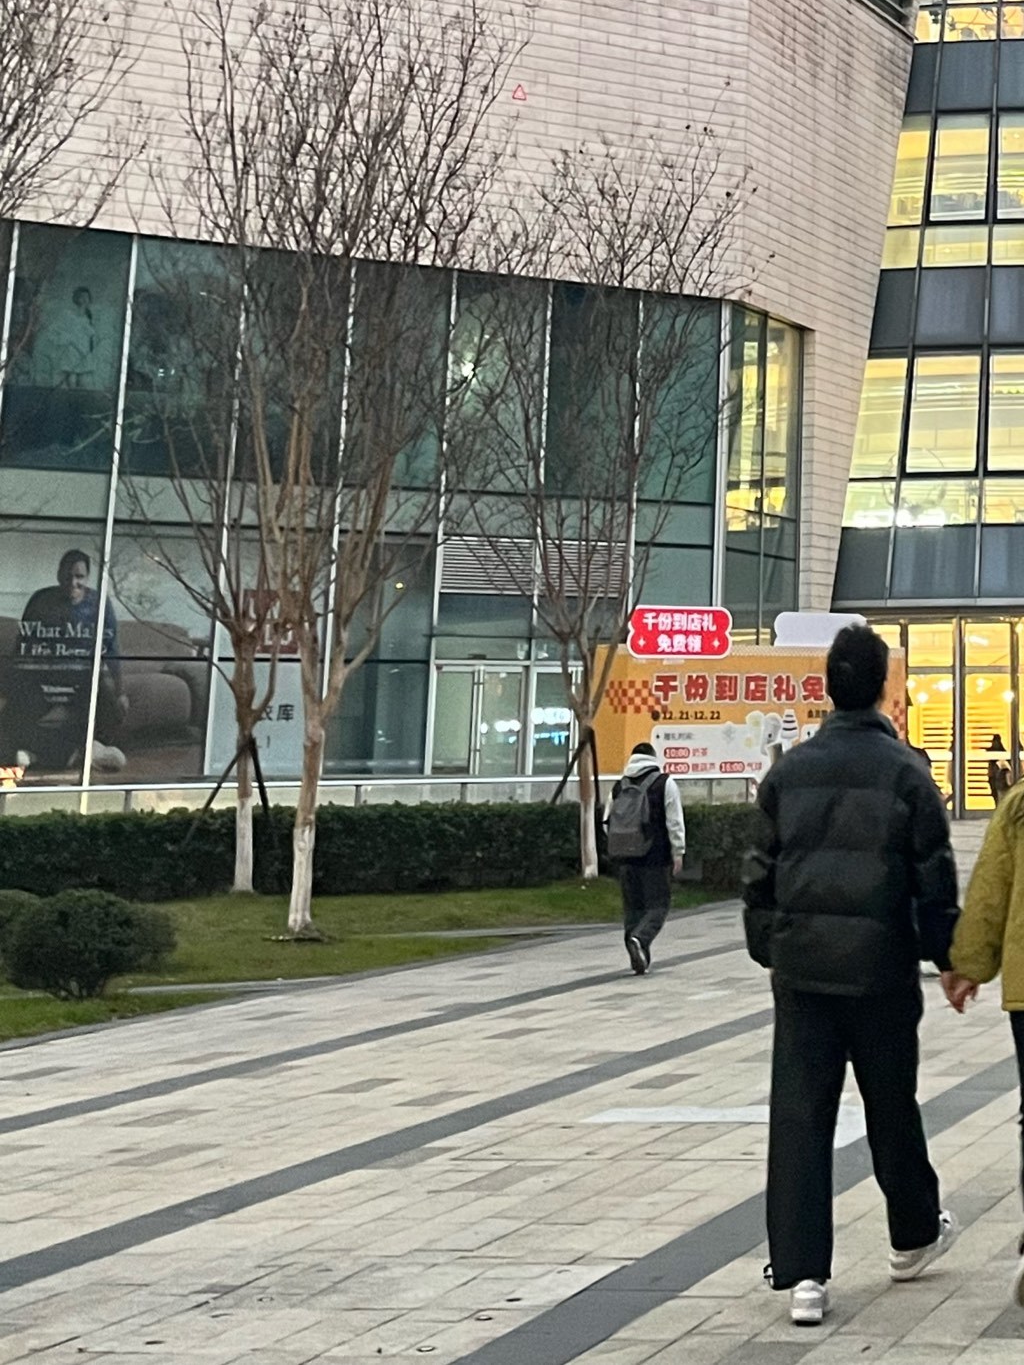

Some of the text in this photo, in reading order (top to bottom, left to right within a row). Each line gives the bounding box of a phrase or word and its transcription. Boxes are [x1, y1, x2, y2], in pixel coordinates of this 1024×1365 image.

[18, 620, 114, 639] What Mas
[642, 611, 717, 632] 千份到店礼
[656, 633, 703, 653] 免费领
